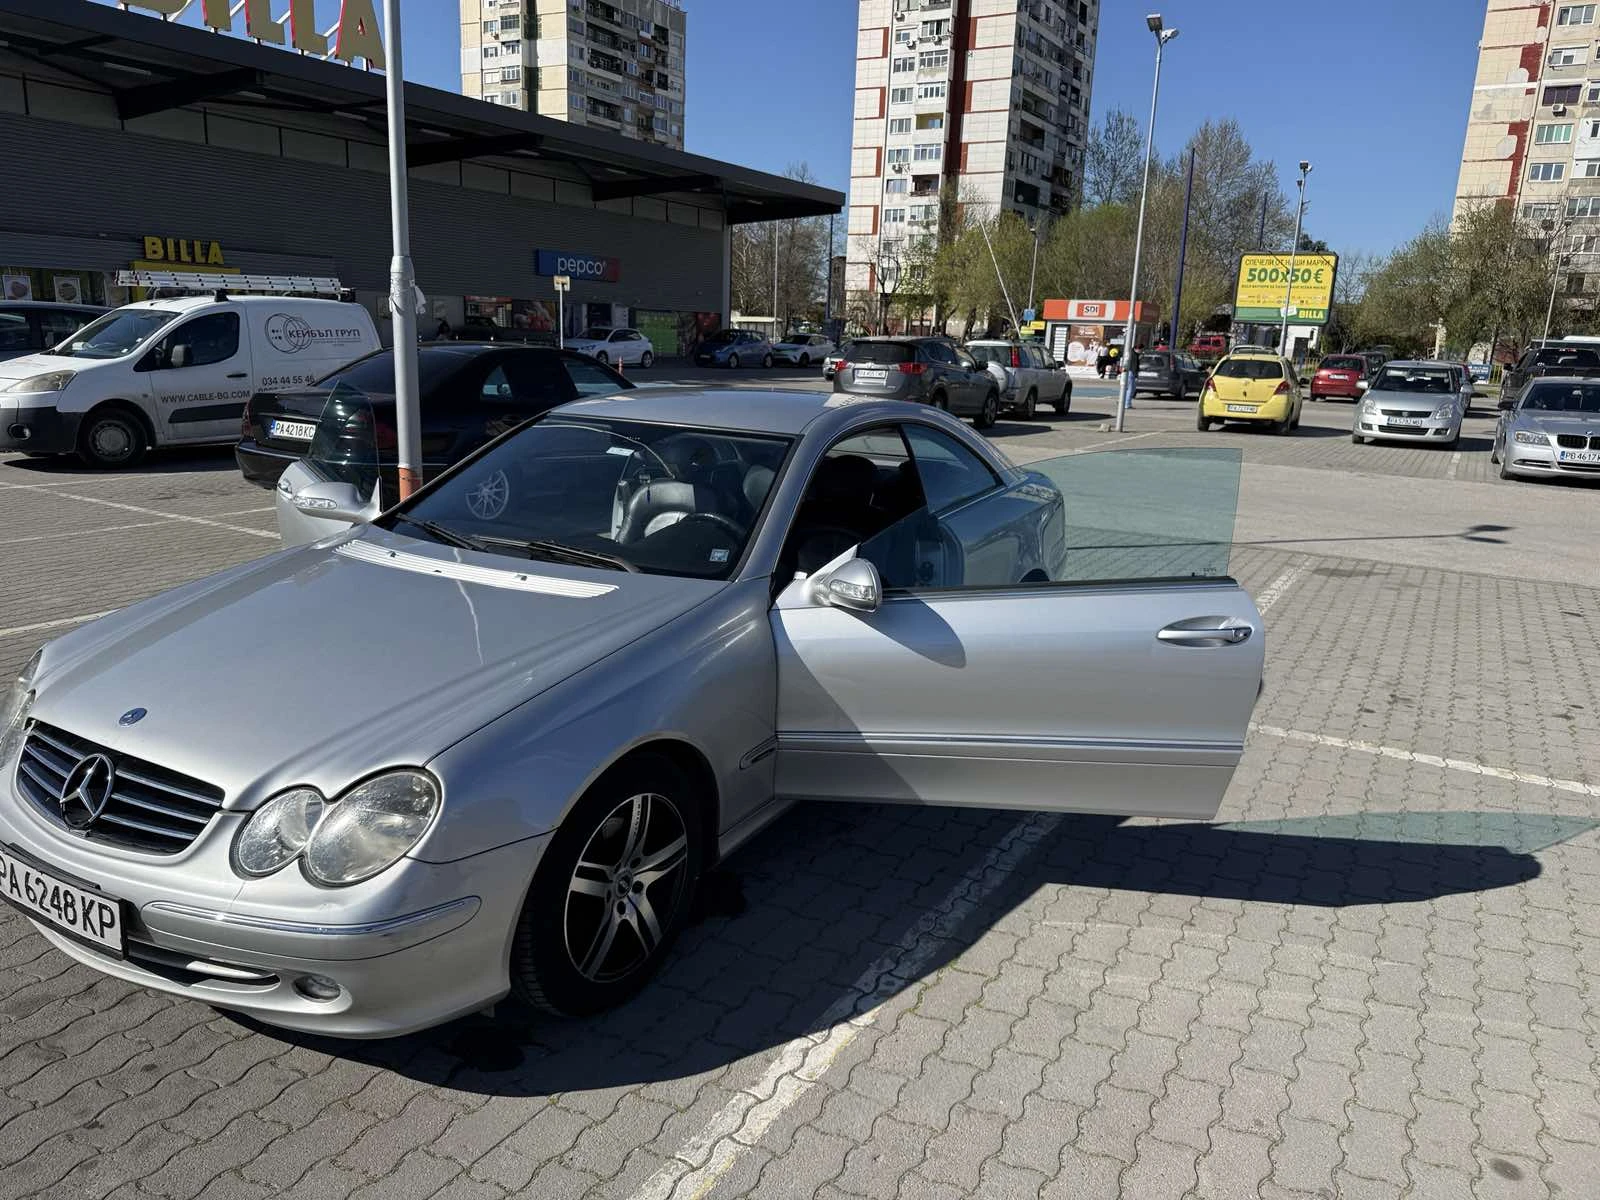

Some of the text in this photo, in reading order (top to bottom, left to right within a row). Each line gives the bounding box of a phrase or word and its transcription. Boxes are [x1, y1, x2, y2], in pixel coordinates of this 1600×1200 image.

[118, 0, 386, 68] LLA
[144, 236, 224, 265] BILLA
[558, 256, 603, 277] pepco
[1084, 305, 1098, 313] SDI
[1299, 310, 1324, 319] BILLA
[288, 327, 361, 339] КЕЙБЪЛ ГРУП
[262, 376, 278, 386] 034
[280, 375, 291, 385] 44
[160, 390, 249, 403] WWW.CABLE-BG.COM
